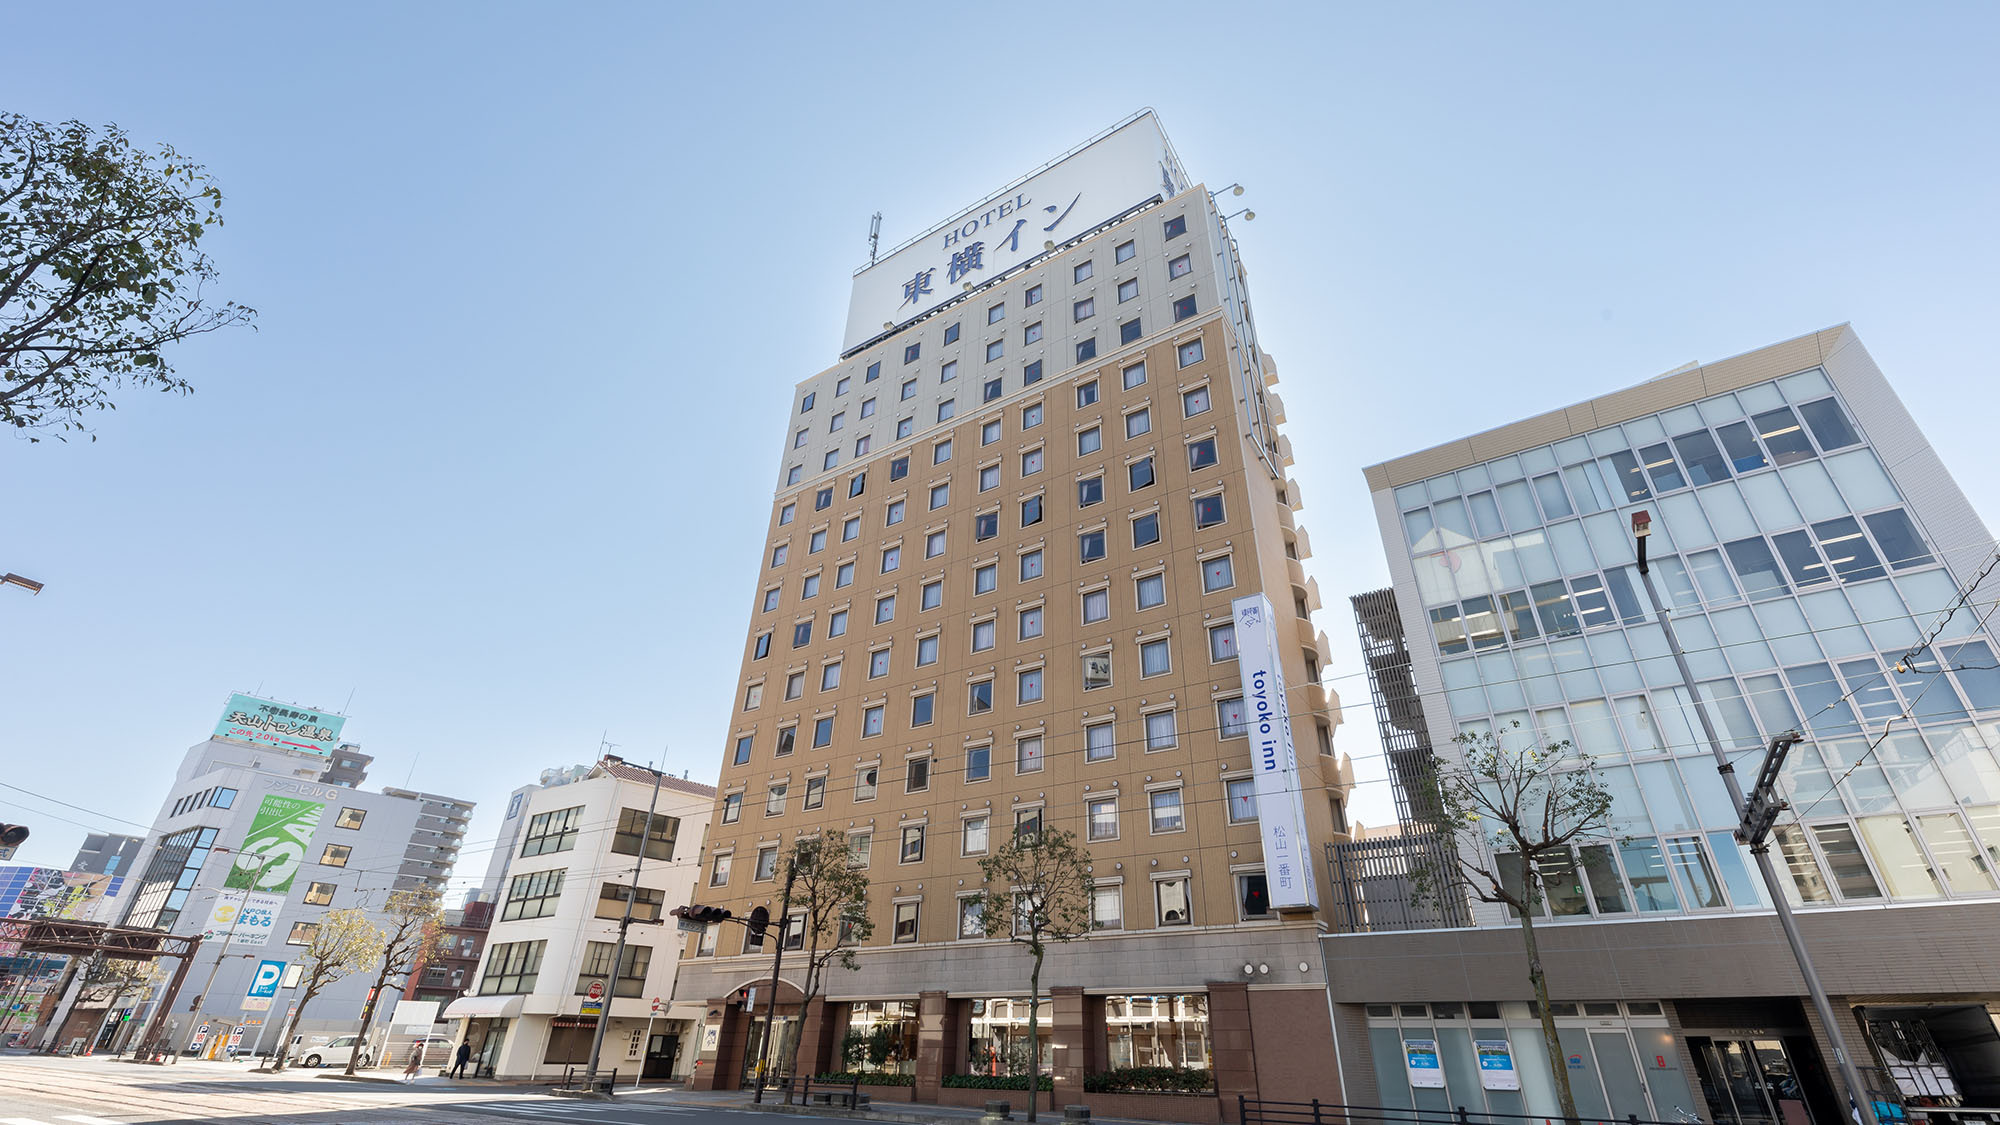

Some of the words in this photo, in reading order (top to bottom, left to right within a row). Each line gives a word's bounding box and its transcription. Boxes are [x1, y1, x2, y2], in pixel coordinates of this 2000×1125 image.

[942, 192, 1032, 250] HOTEL
[897, 191, 1082, 311] 東横イン
[224, 711, 335, 742] 天山トロン温泉
[1252, 670, 1273, 734] toyoko
[1262, 740, 1277, 771] inn
[1273, 825, 1292, 889] 松山一番町
[251, 964, 280, 994] P
